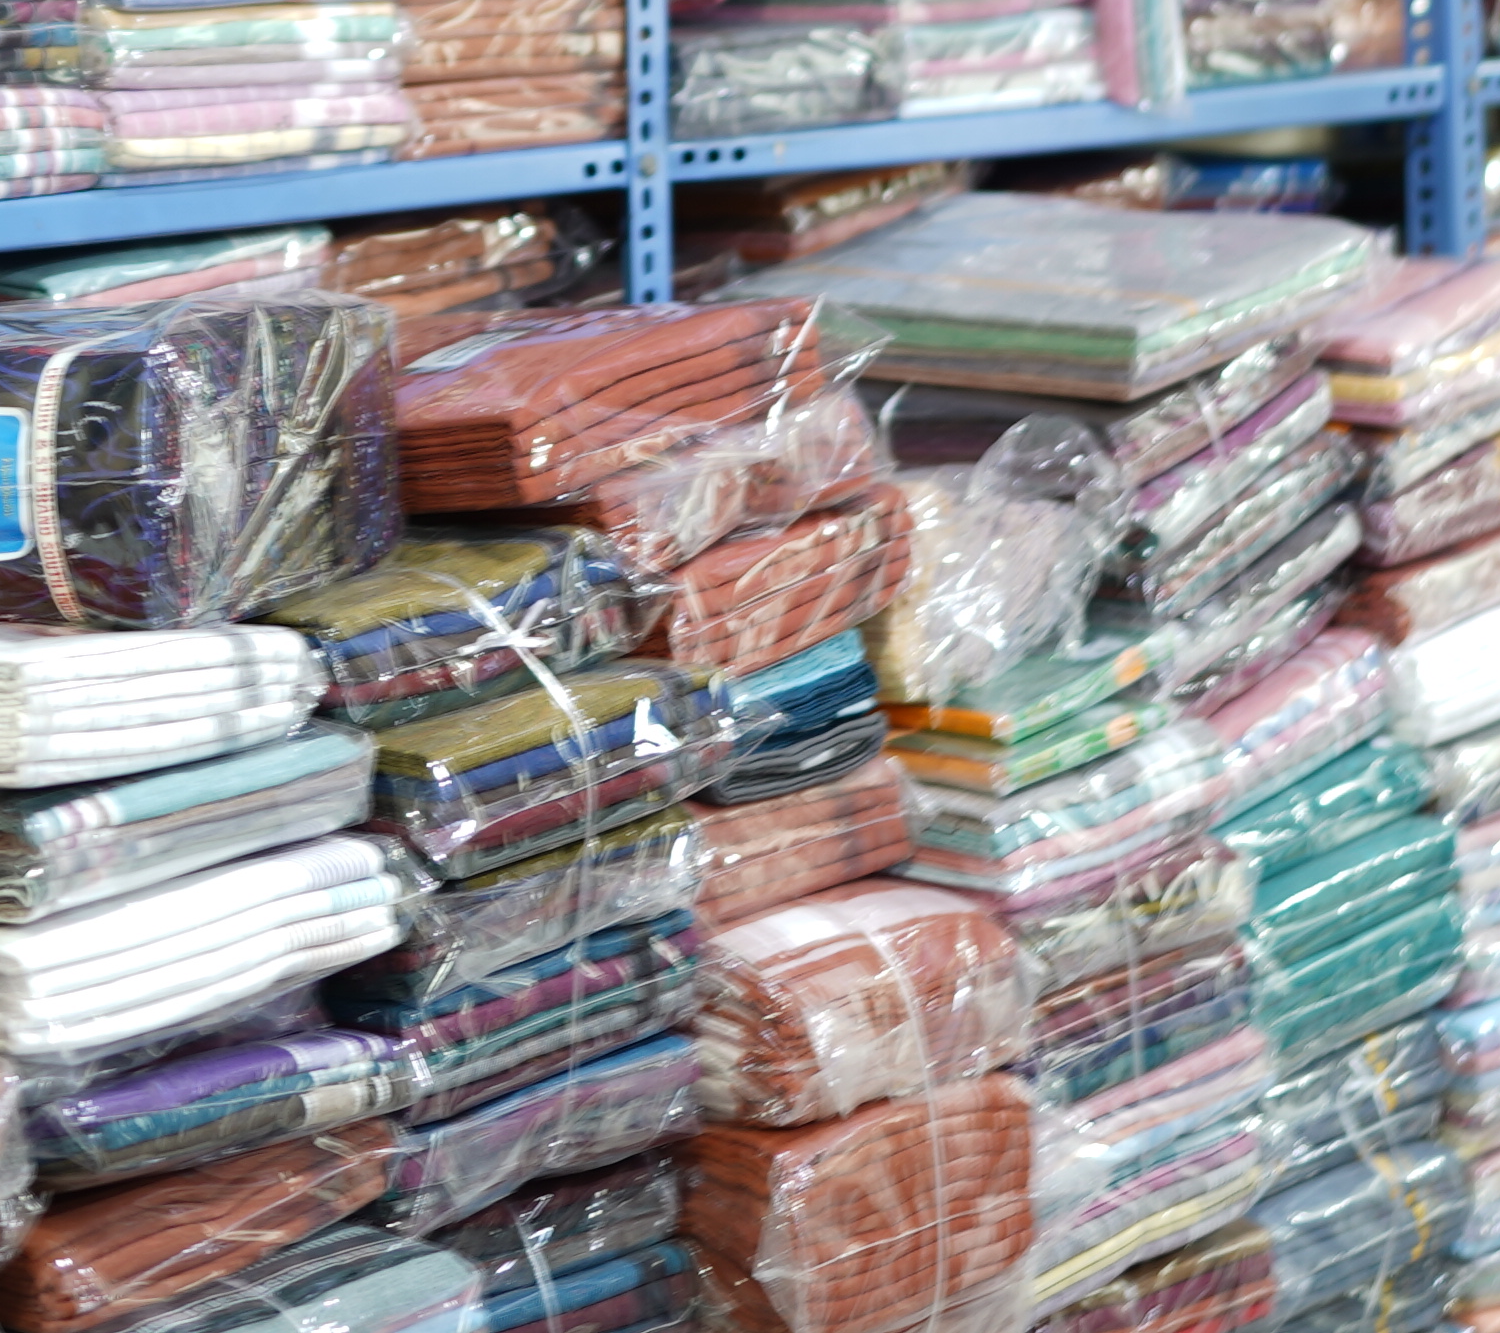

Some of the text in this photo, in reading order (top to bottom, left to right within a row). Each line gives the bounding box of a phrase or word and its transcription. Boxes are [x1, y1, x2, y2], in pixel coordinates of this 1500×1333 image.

[34, 366, 63, 433] CENTURY
[34, 455, 51, 473] ST
[34, 482, 52, 536] BRAND
[42, 541, 66, 588] SOUTH
